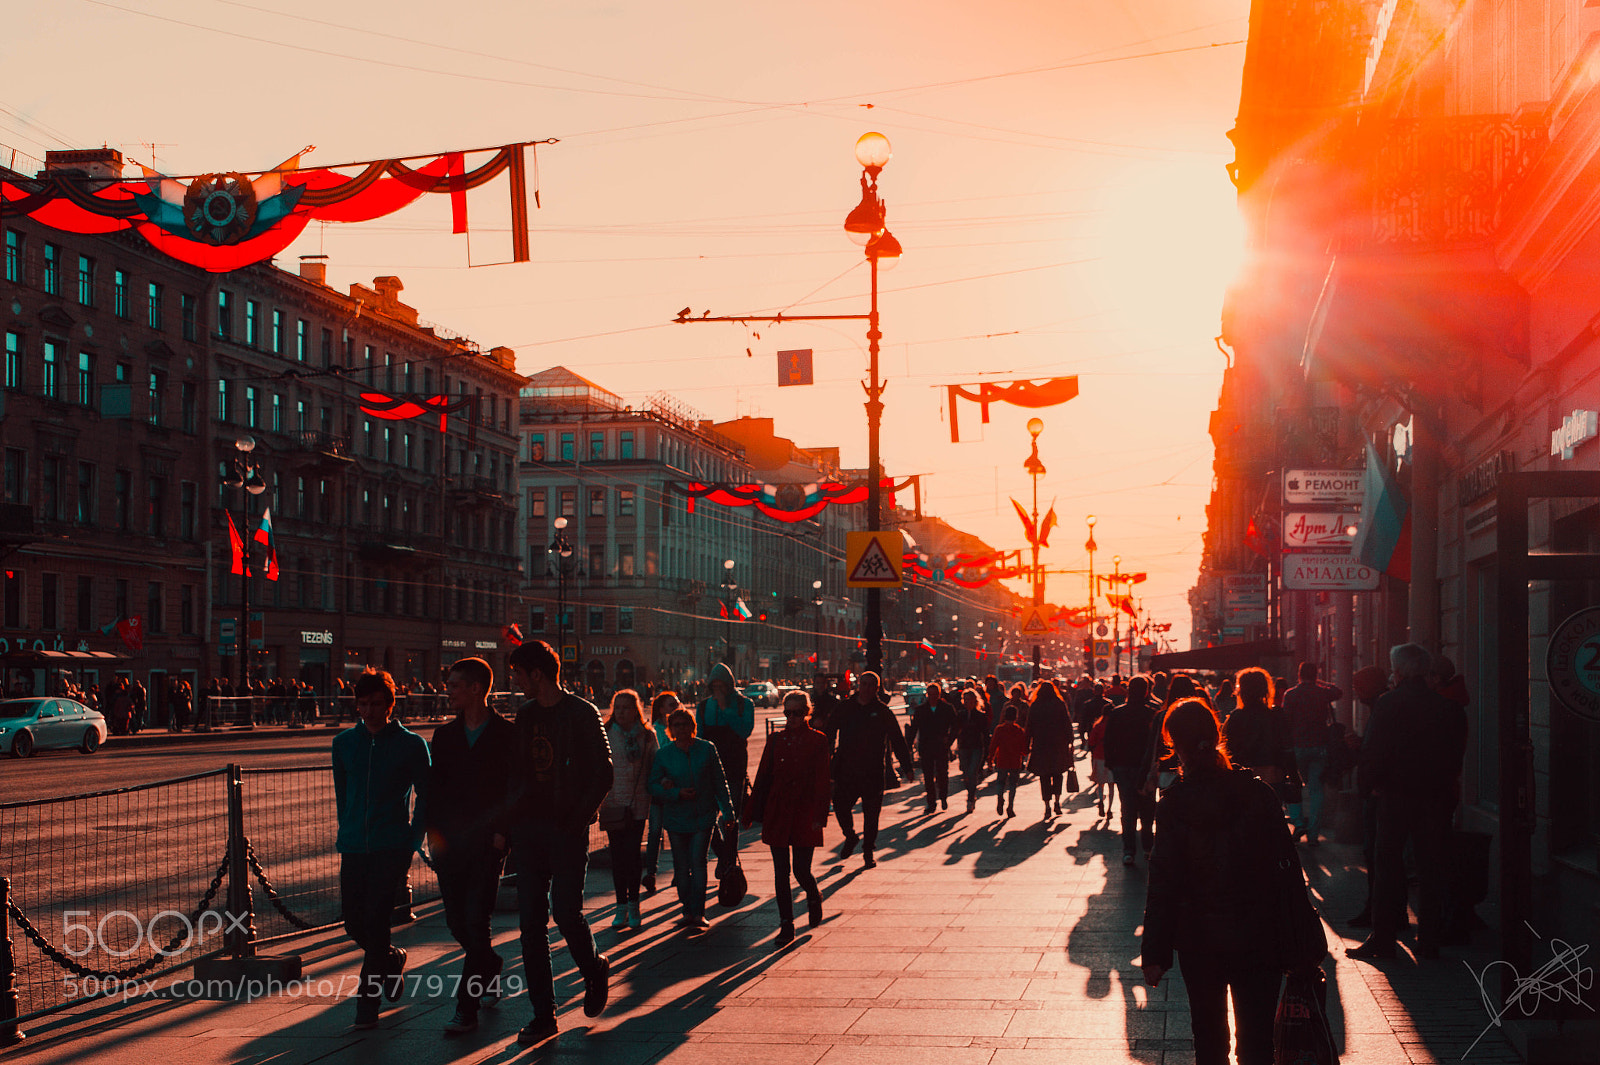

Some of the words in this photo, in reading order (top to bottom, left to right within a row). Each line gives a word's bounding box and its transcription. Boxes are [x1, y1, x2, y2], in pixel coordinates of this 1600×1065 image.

[1305, 480, 1360, 490] РЕМОНТ
[1292, 515, 1326, 543] Арт
[1293, 567, 1370, 580] АМАДЕО
[300, 629, 333, 645] TEZENIS
